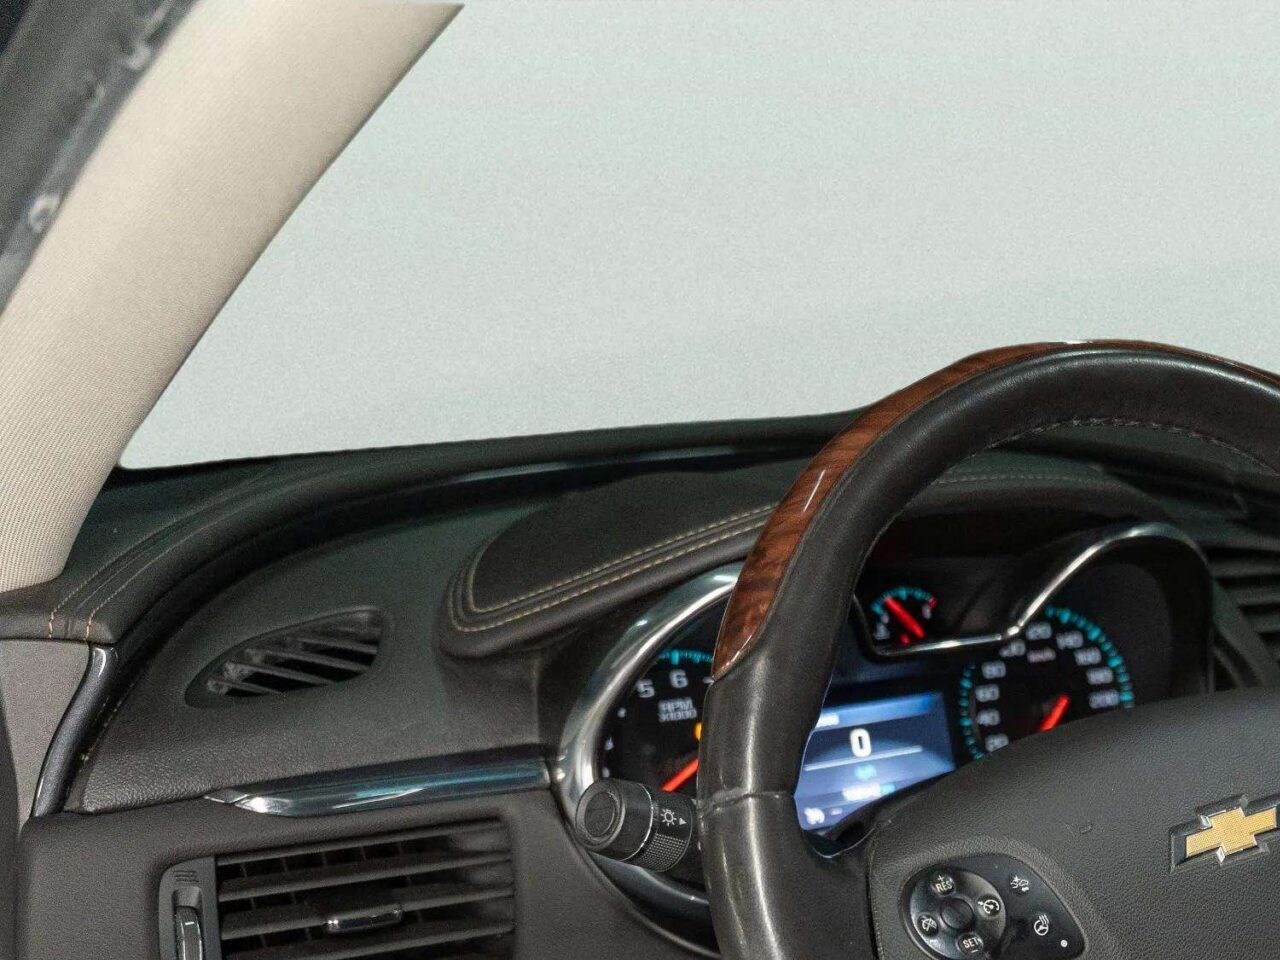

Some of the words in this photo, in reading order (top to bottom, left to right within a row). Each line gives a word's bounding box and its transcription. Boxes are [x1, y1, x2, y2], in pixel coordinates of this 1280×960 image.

[636, 678, 655, 698] 5
[669, 669, 688, 689] 6
[850, 728, 872, 758] 0
[935, 880, 952, 892] RES
[962, 937, 979, 949] SET
